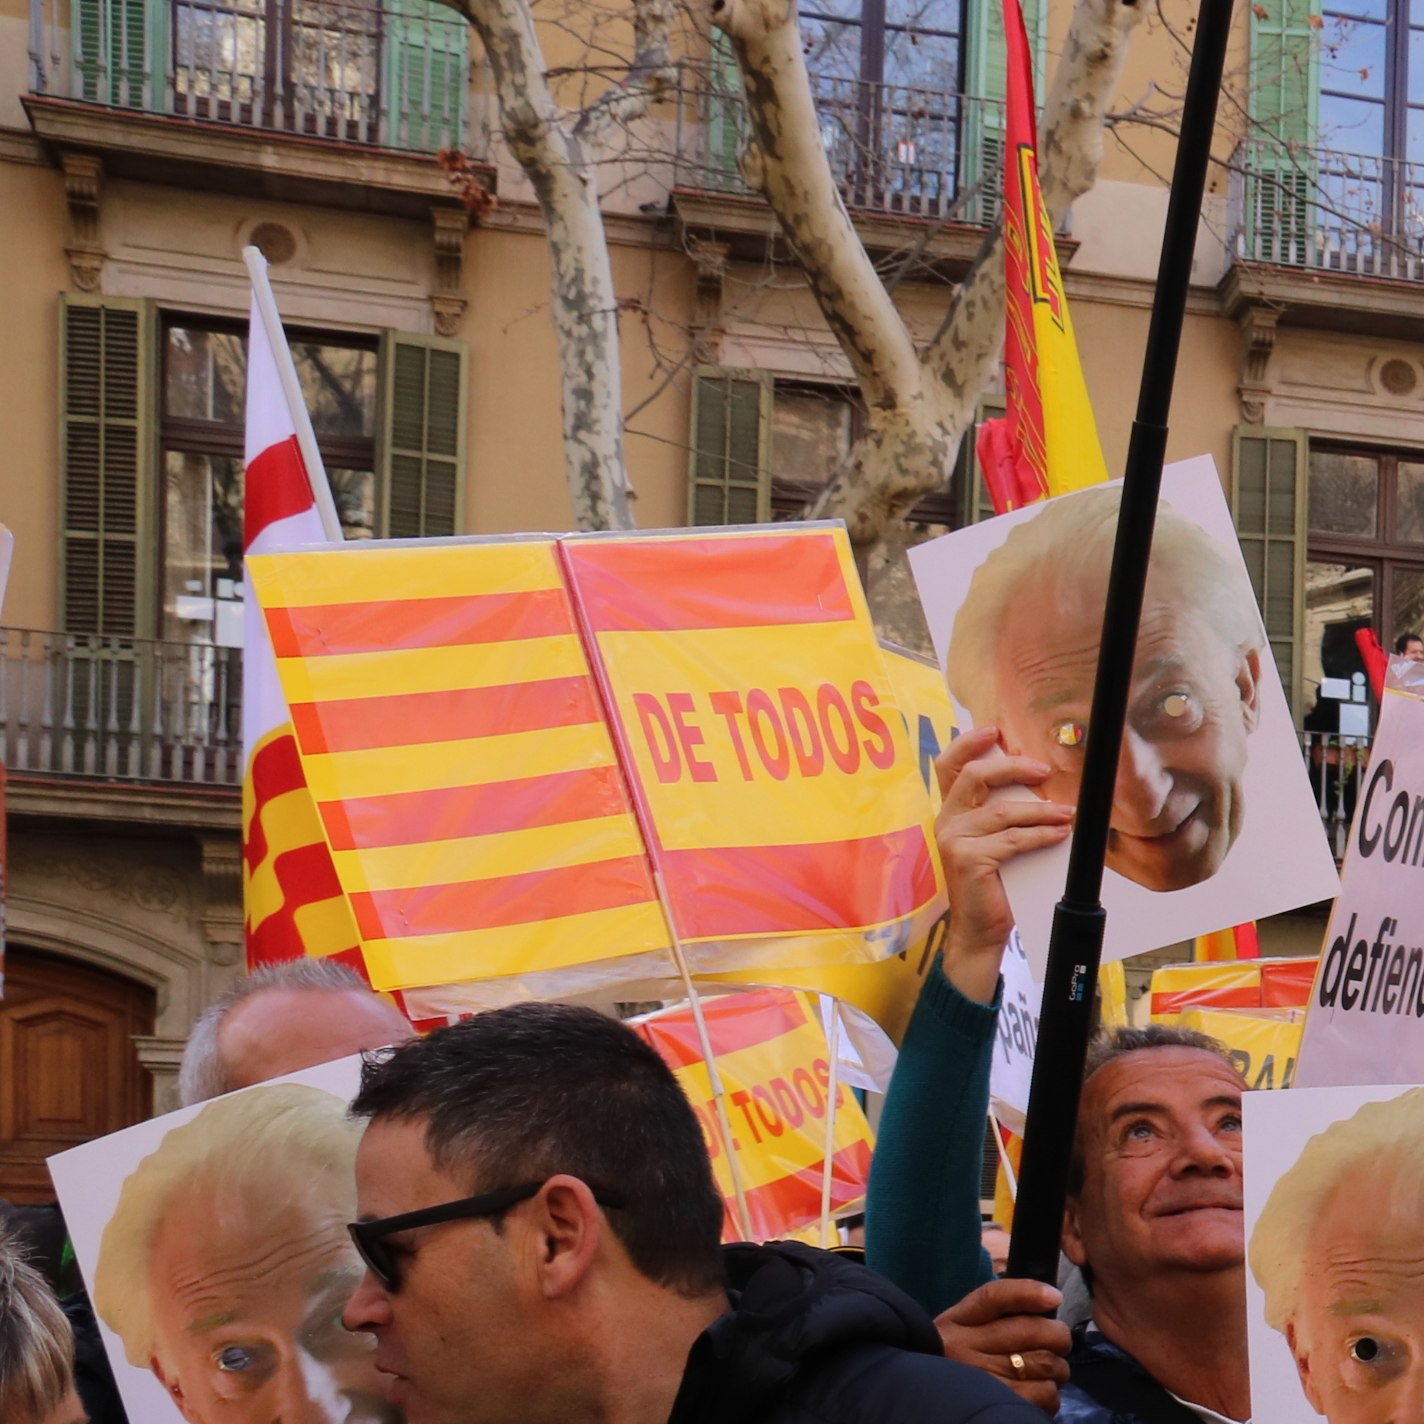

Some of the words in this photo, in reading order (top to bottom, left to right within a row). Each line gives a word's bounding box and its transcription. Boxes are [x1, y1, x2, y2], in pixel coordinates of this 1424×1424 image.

[633, 692, 718, 784] DE
[709, 680, 896, 782] TODOS
[1069, 964, 1081, 1001] GoPro
[730, 1058, 844, 1144] TODOS
